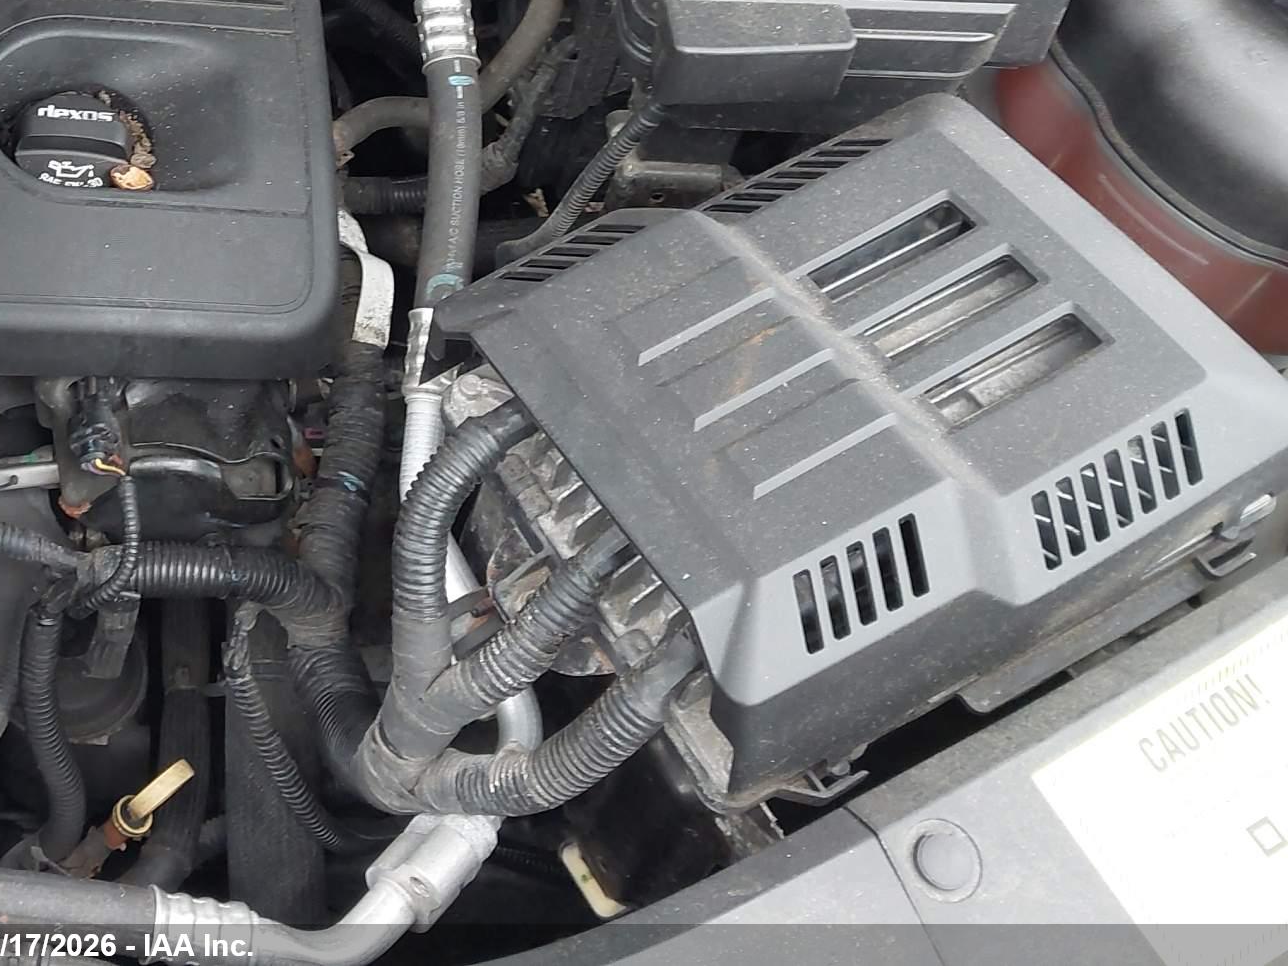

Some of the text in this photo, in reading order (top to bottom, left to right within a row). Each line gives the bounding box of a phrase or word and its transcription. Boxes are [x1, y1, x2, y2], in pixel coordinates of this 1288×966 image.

[37, 104, 116, 122] dexos
[452, 158, 465, 185] HOSE
[448, 186, 464, 226] SUCTION
[1138, 673, 1272, 773] CAUTION!
